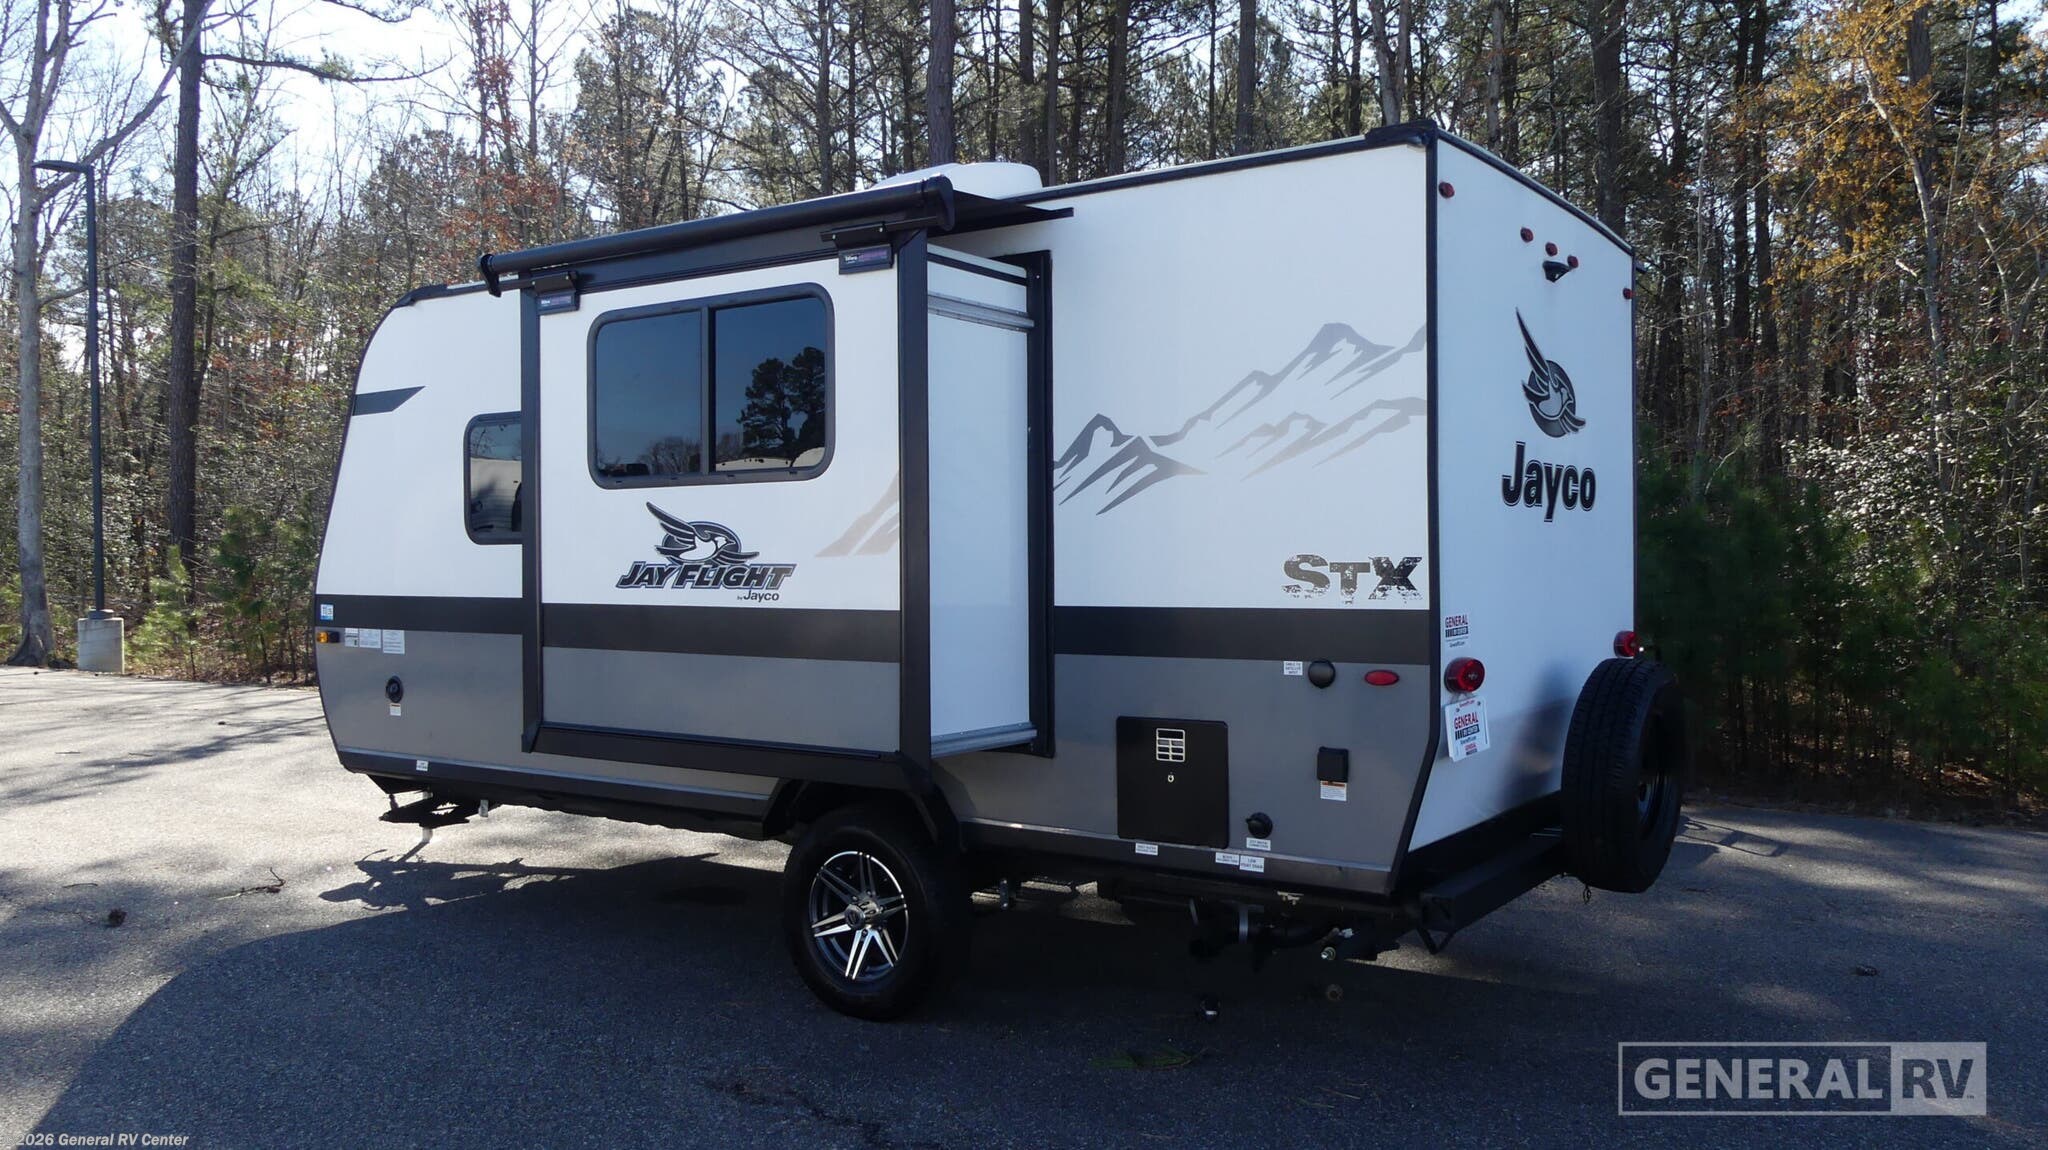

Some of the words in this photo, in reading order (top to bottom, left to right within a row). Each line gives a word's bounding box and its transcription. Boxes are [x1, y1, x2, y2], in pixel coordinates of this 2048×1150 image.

[1502, 441, 1596, 522] Jayco
[615, 561, 681, 588] JAY
[671, 563, 797, 590] FLIGHT
[744, 588, 780, 603] Jayco
[1445, 614, 1469, 628] GENERAL
[1454, 711, 1479, 730] GENERAL
